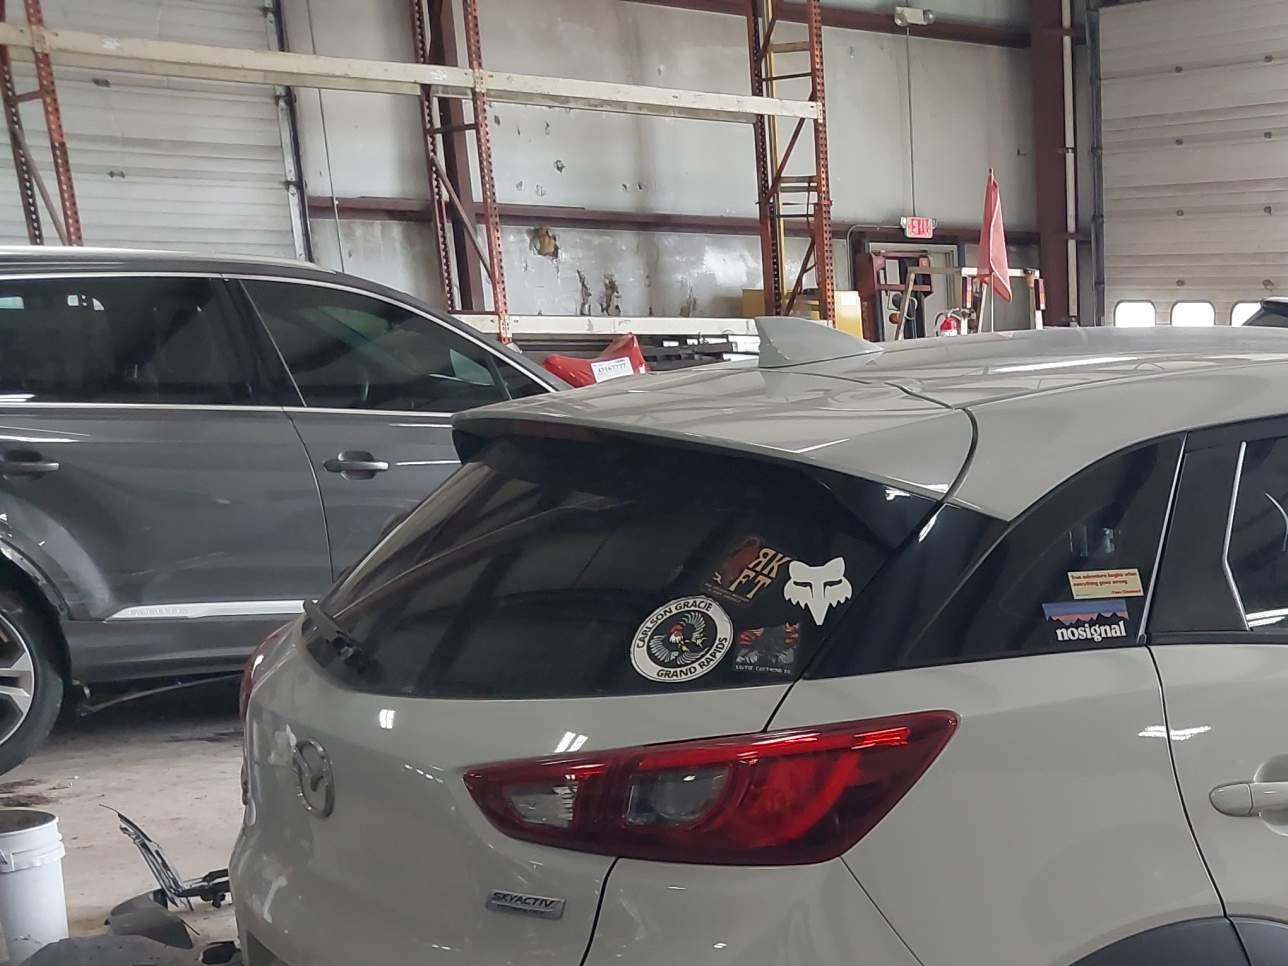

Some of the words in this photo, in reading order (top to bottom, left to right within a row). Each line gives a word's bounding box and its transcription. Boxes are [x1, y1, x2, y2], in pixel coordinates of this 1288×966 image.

[637, 607, 674, 649] CARLSON
[674, 600, 713, 613] GRACIE
[1056, 620, 1127, 642] nosignal
[656, 664, 698, 679] GRAND
[699, 637, 728, 670] RAPIDS
[491, 892, 555, 908] SKYACTIV
